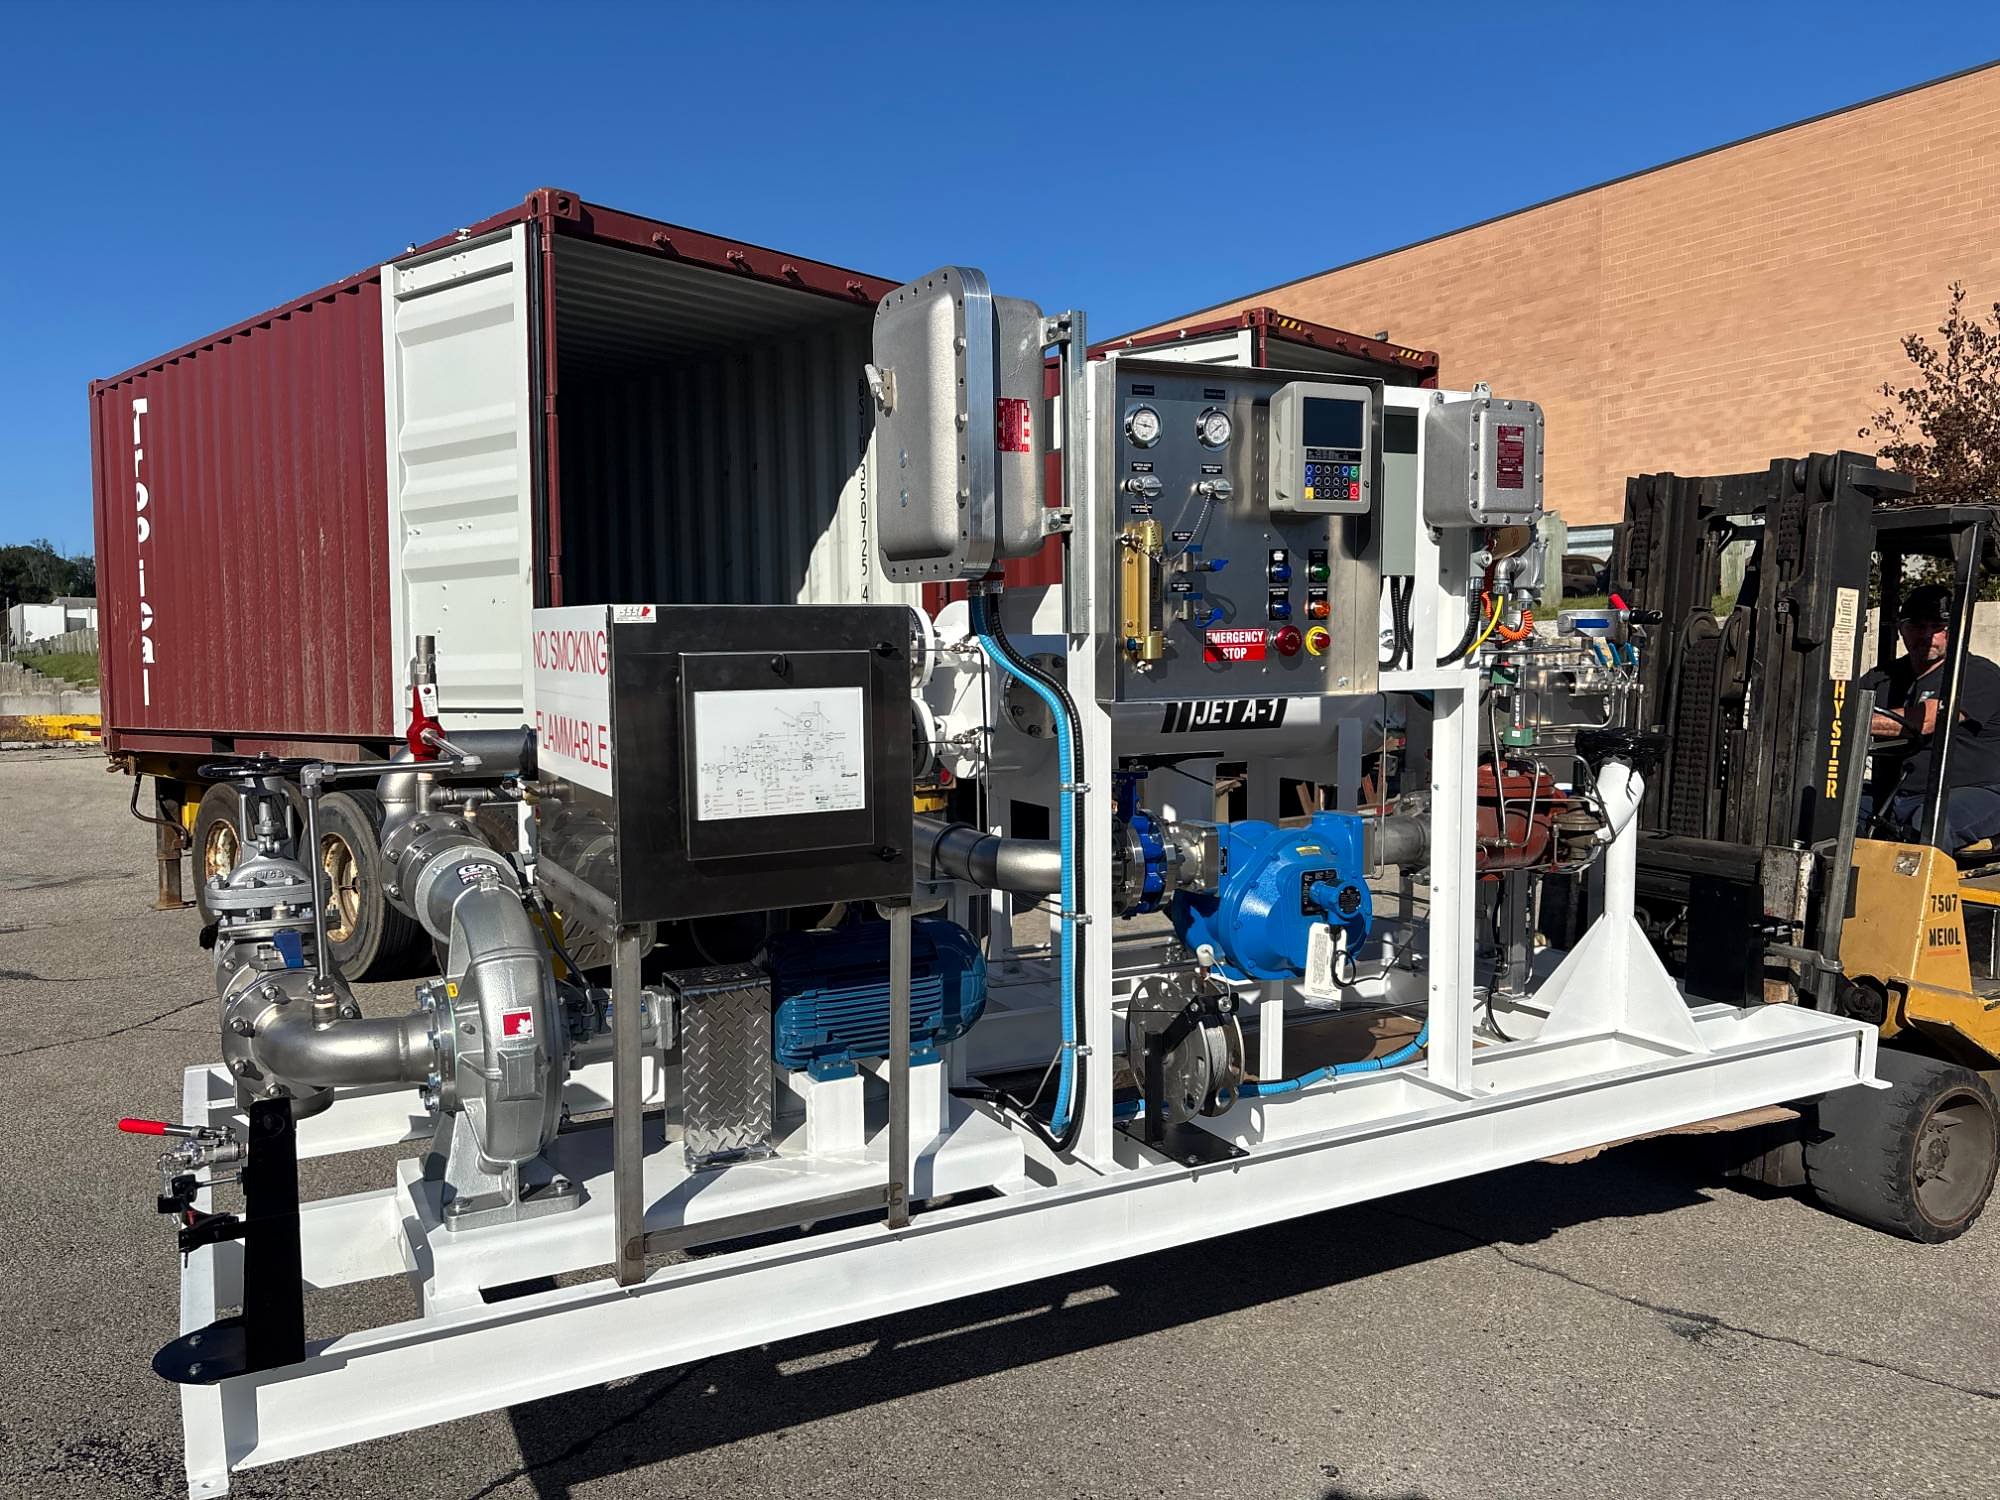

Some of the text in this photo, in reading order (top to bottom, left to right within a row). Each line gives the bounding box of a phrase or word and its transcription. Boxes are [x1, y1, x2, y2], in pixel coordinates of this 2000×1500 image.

[861, 585, 869, 602] 4
[1206, 631, 1264, 644] EMERGENCY
[533, 630, 608, 675] NO SMOKING
[1222, 647, 1248, 660] STOP
[1195, 698, 1279, 725] JET A-1
[536, 711, 608, 770] FLAMMABLE
[1930, 894, 1958, 913] 7507
